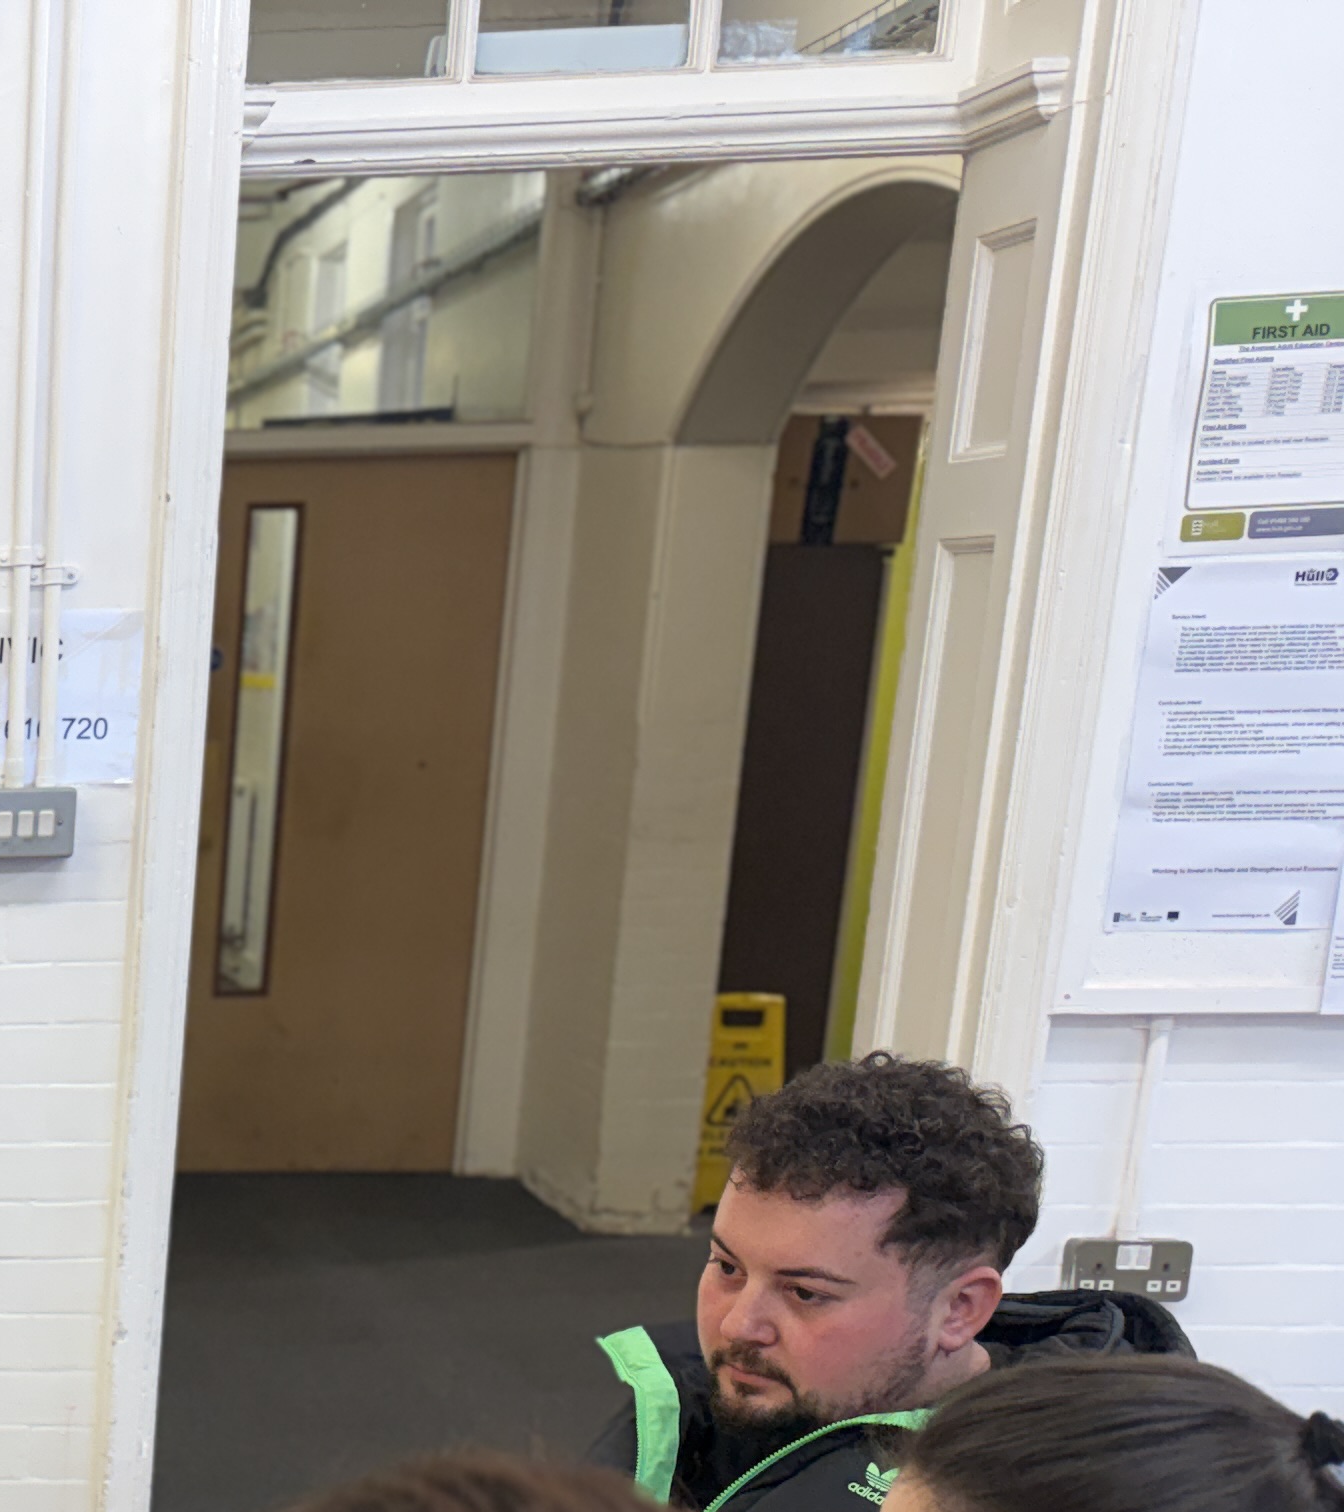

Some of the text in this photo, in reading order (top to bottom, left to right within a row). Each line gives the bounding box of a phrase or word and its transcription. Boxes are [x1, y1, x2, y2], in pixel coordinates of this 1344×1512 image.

[1252, 322, 1331, 340] FIRST AID
[1294, 569, 1325, 583] Hull
[61, 716, 110, 741] 720
[847, 1480, 887, 1506] adida
